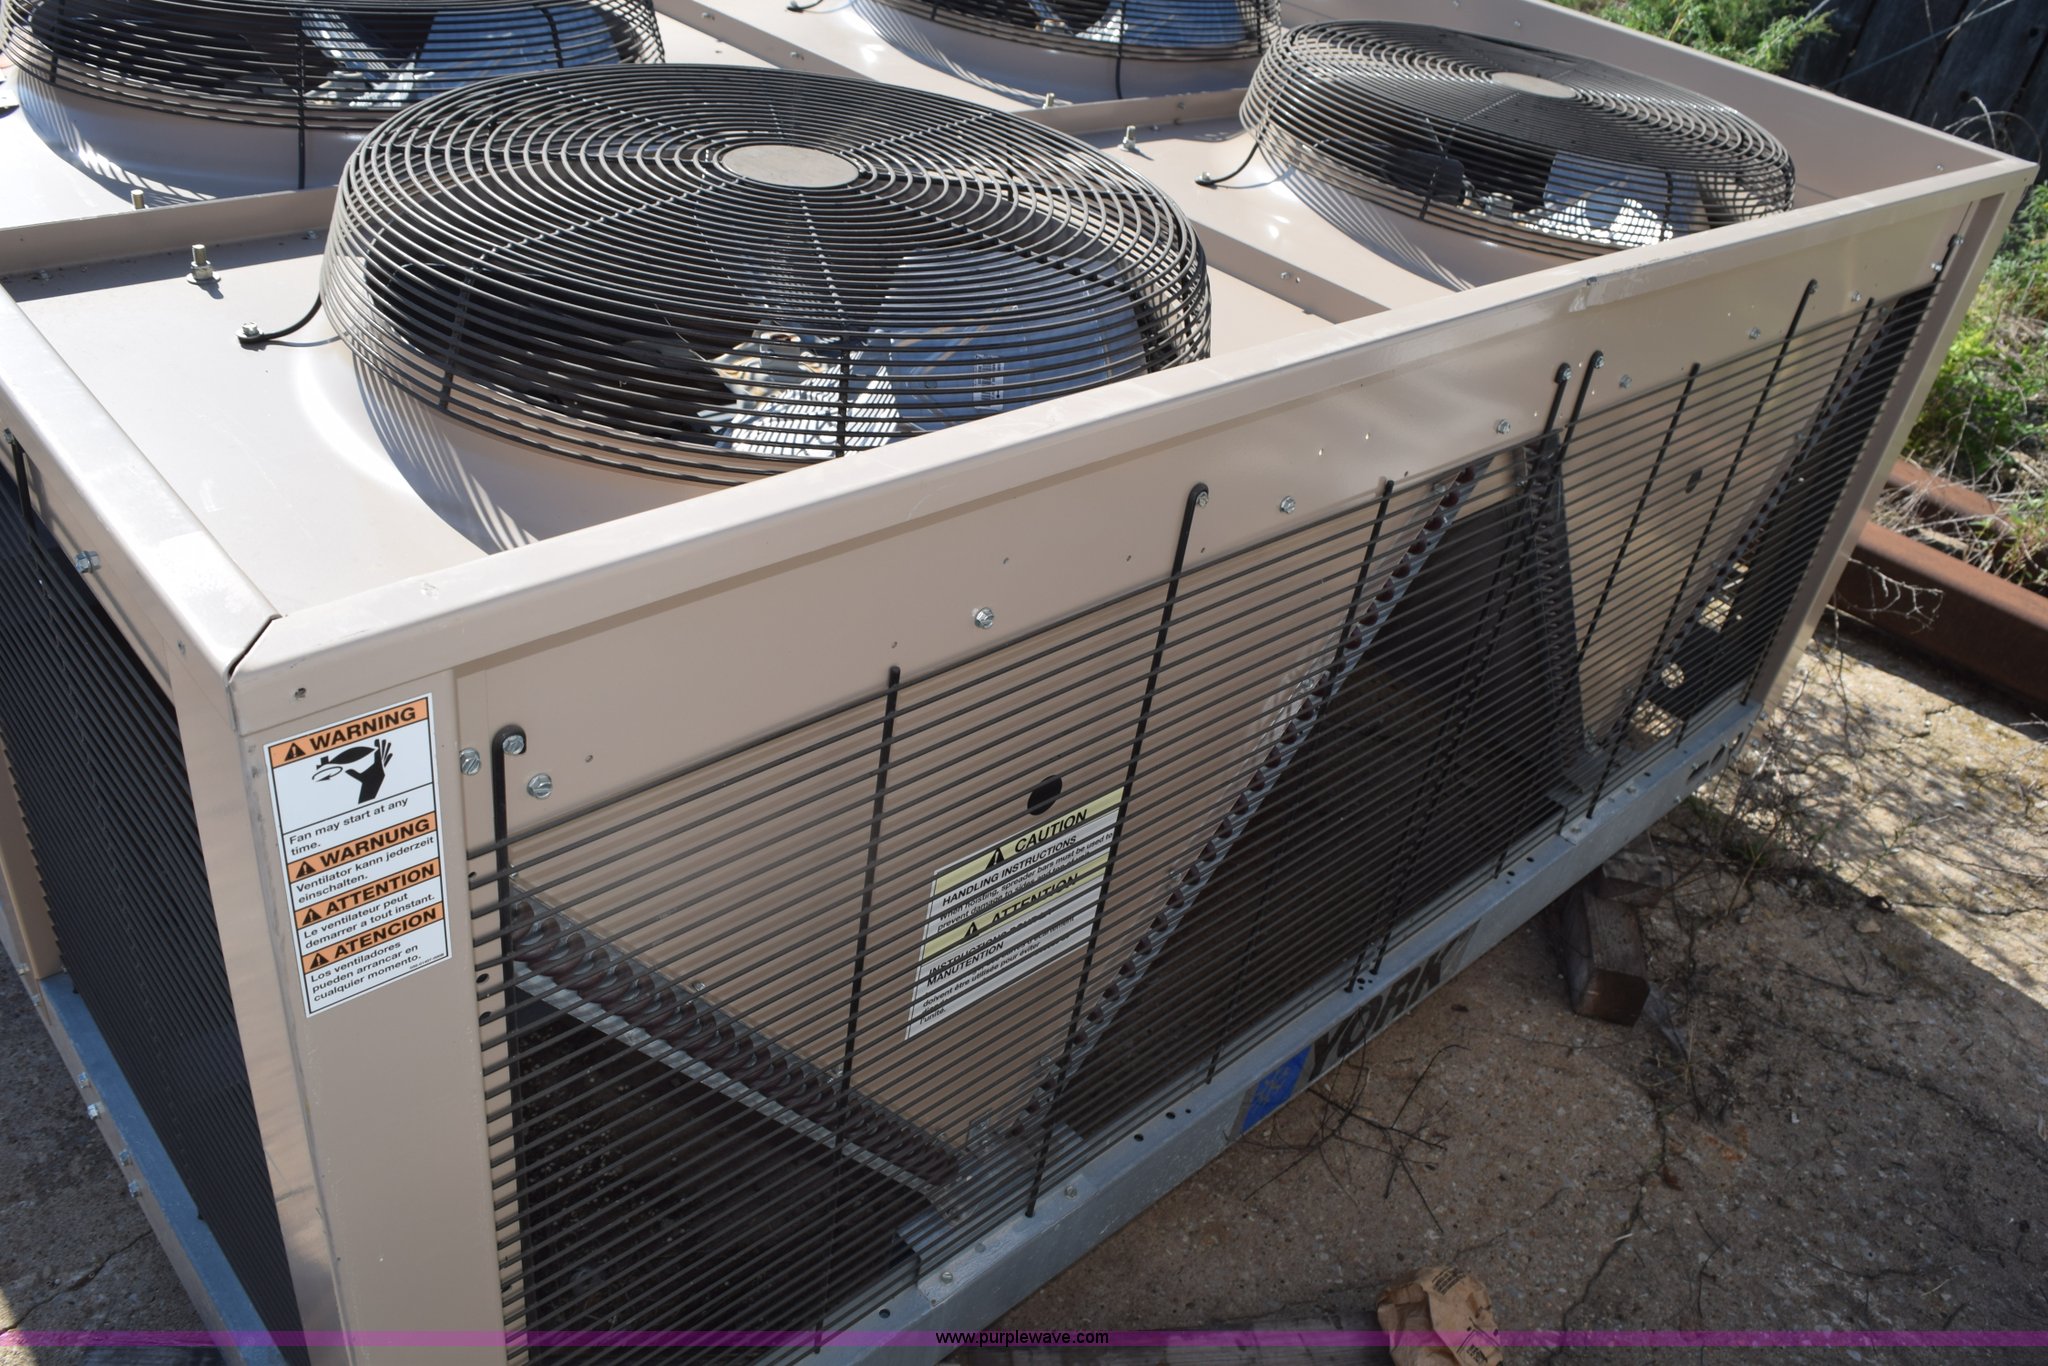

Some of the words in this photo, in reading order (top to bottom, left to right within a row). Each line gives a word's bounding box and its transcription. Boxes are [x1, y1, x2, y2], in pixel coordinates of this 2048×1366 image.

[310, 707, 416, 750] WARNING
[289, 832, 312, 844] Fan
[315, 822, 340, 835] may
[343, 811, 371, 826] start
[373, 805, 385, 815] at
[388, 798, 409, 811] any
[320, 819, 430, 867] WARNUNG
[1015, 809, 1087, 853] CAUTION
[291, 843, 321, 856] time.
[296, 868, 352, 893] Ventilator
[355, 856, 383, 871] kann
[386, 836, 434, 862] jederzeit
[942, 873, 999, 907] HANDLING
[1001, 835, 1077, 879] INSTRUCTIONS
[1001, 870, 1036, 892] spreader
[1037, 860, 1054, 872] bars
[1056, 850, 1075, 865] must
[1075, 844, 1086, 854] be
[1086, 836, 1104, 849] used
[1105, 832, 1113, 841] to
[298, 874, 368, 904] einschalten.
[326, 863, 435, 915] ATTENTION
[303, 928, 318, 939] Le
[321, 904, 380, 933] ventilateur
[383, 893, 408, 910] peut
[305, 924, 358, 949] demarrer
[360, 919, 368, 928] a
[370, 909, 392, 924] tout
[395, 893, 435, 915] instant.
[334, 908, 436, 959] ATENCION
[938, 911, 969, 931] prevent
[311, 970, 331, 983] Los
[334, 942, 401, 974] ventiladores
[312, 971, 354, 994] pueden
[356, 952, 402, 974] arrancar
[405, 944, 418, 954] en
[314, 976, 364, 1002] cualquier
[367, 955, 421, 980] momento.
[923, 987, 952, 1007] doivent
[999, 952, 1019, 968] pour
[927, 941, 1004, 987] MANUTENTION
[1308, 936, 1459, 1083] YORK
